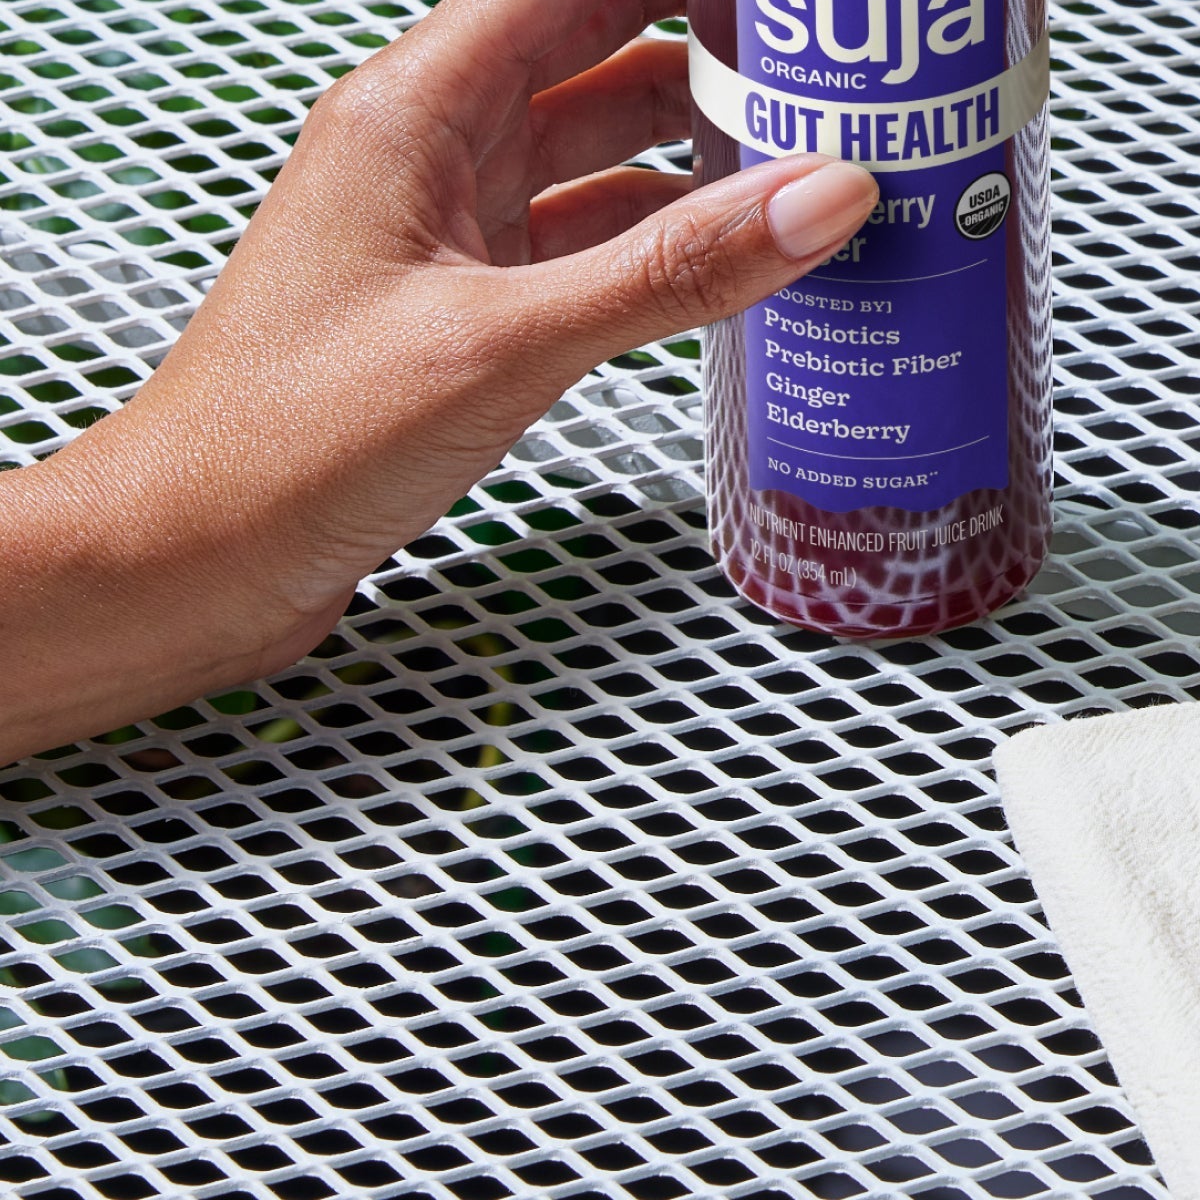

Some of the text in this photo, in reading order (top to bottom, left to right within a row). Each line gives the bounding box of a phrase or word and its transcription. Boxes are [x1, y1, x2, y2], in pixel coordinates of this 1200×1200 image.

[760, 56, 868, 90] ORGANIC
[745, 86, 1000, 162] GUT HEALTH
[868, 194, 936, 229] erry
[964, 201, 1005, 226] ORGANIC
[969, 184, 1001, 209] USDA
[773, 288, 854, 312] OOSTED
[764, 306, 900, 345] Probiotics
[765, 338, 962, 377] Prebiotic Fiber
[766, 371, 850, 409] Ginger
[766, 401, 911, 444] Elderberry
[767, 456, 791, 475] NO
[795, 467, 857, 489] ADDED
[750, 502, 1004, 553] NUTRIENT ENHANCED FRUIT JUICE DRINK
[750, 538, 857, 589] 12 FL OZ (354 mL)
